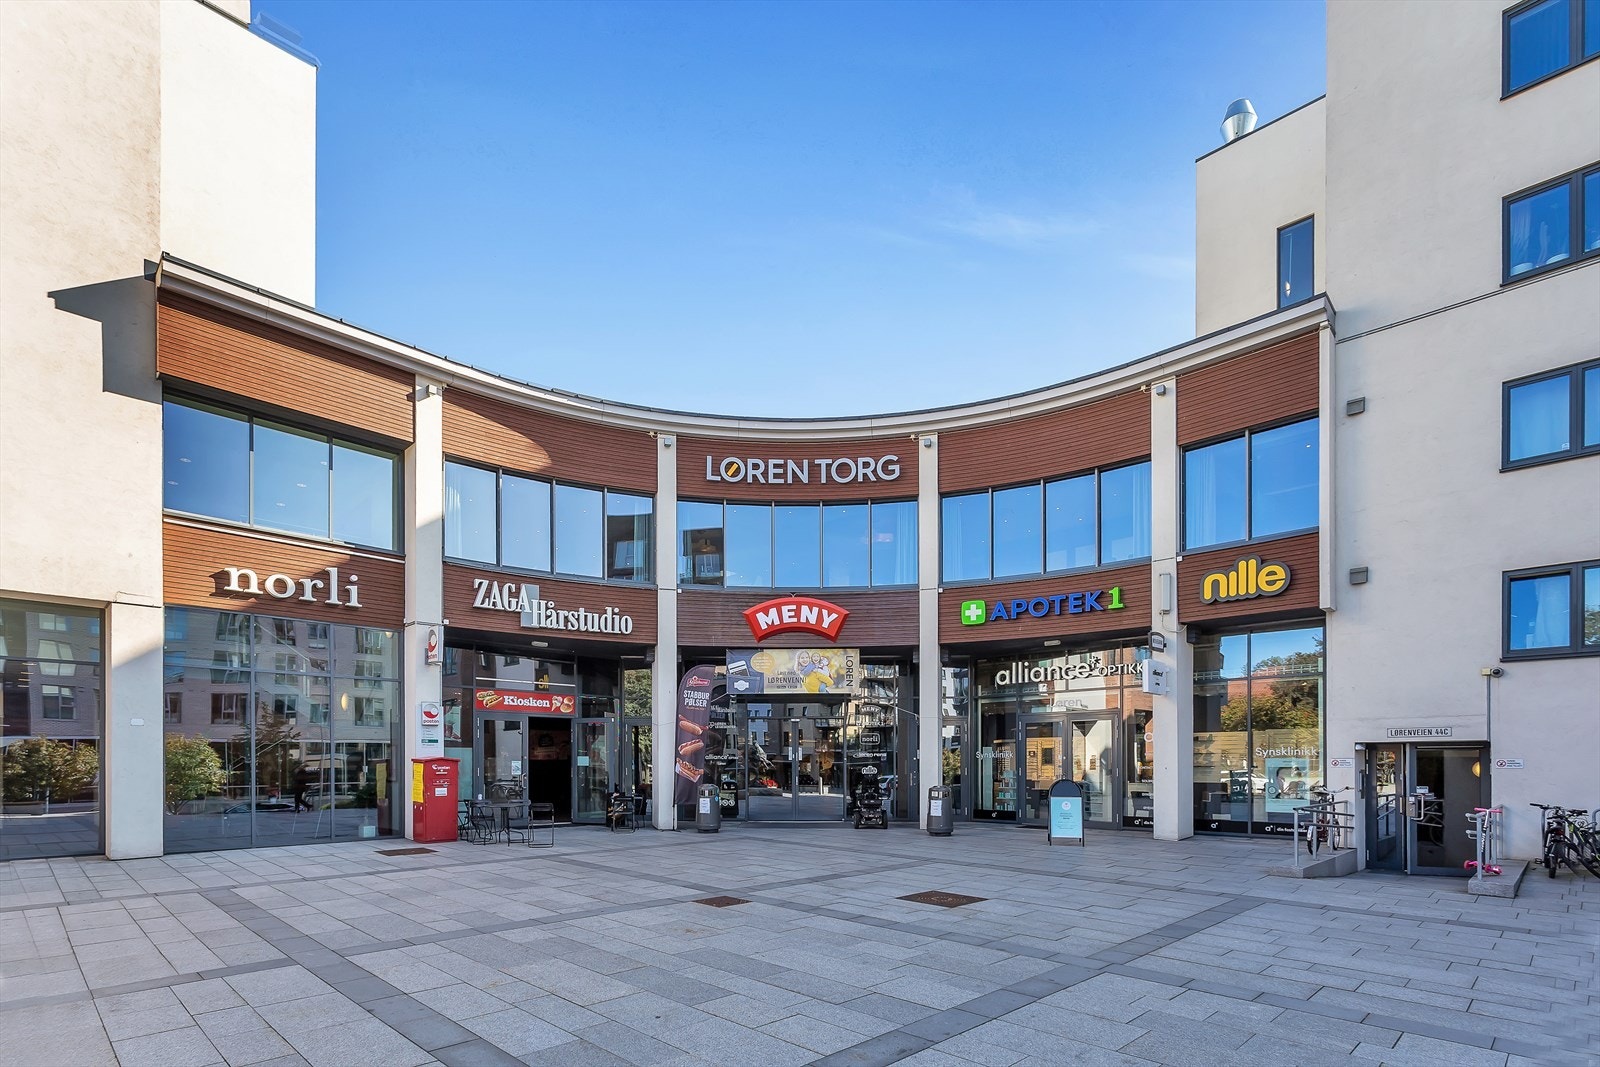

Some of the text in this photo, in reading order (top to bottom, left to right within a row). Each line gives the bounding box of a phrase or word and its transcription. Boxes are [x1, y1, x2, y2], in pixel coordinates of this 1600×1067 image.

[814, 454, 900, 484] TORG
[223, 566, 363, 608] norli
[1203, 558, 1286, 600] nille
[472, 578, 533, 614] ZAGA
[989, 586, 1124, 621] APOTEK 1
[530, 599, 633, 635] Hårstudio
[755, 604, 839, 630] MENY
[995, 661, 1090, 686] alliance
[503, 695, 551, 708] Kiosken
[1390, 728, 1449, 737] LØRENVEIEN 44C
[975, 750, 1014, 763] Synsklinikk
[1255, 746, 1319, 758] Synsklinikk
